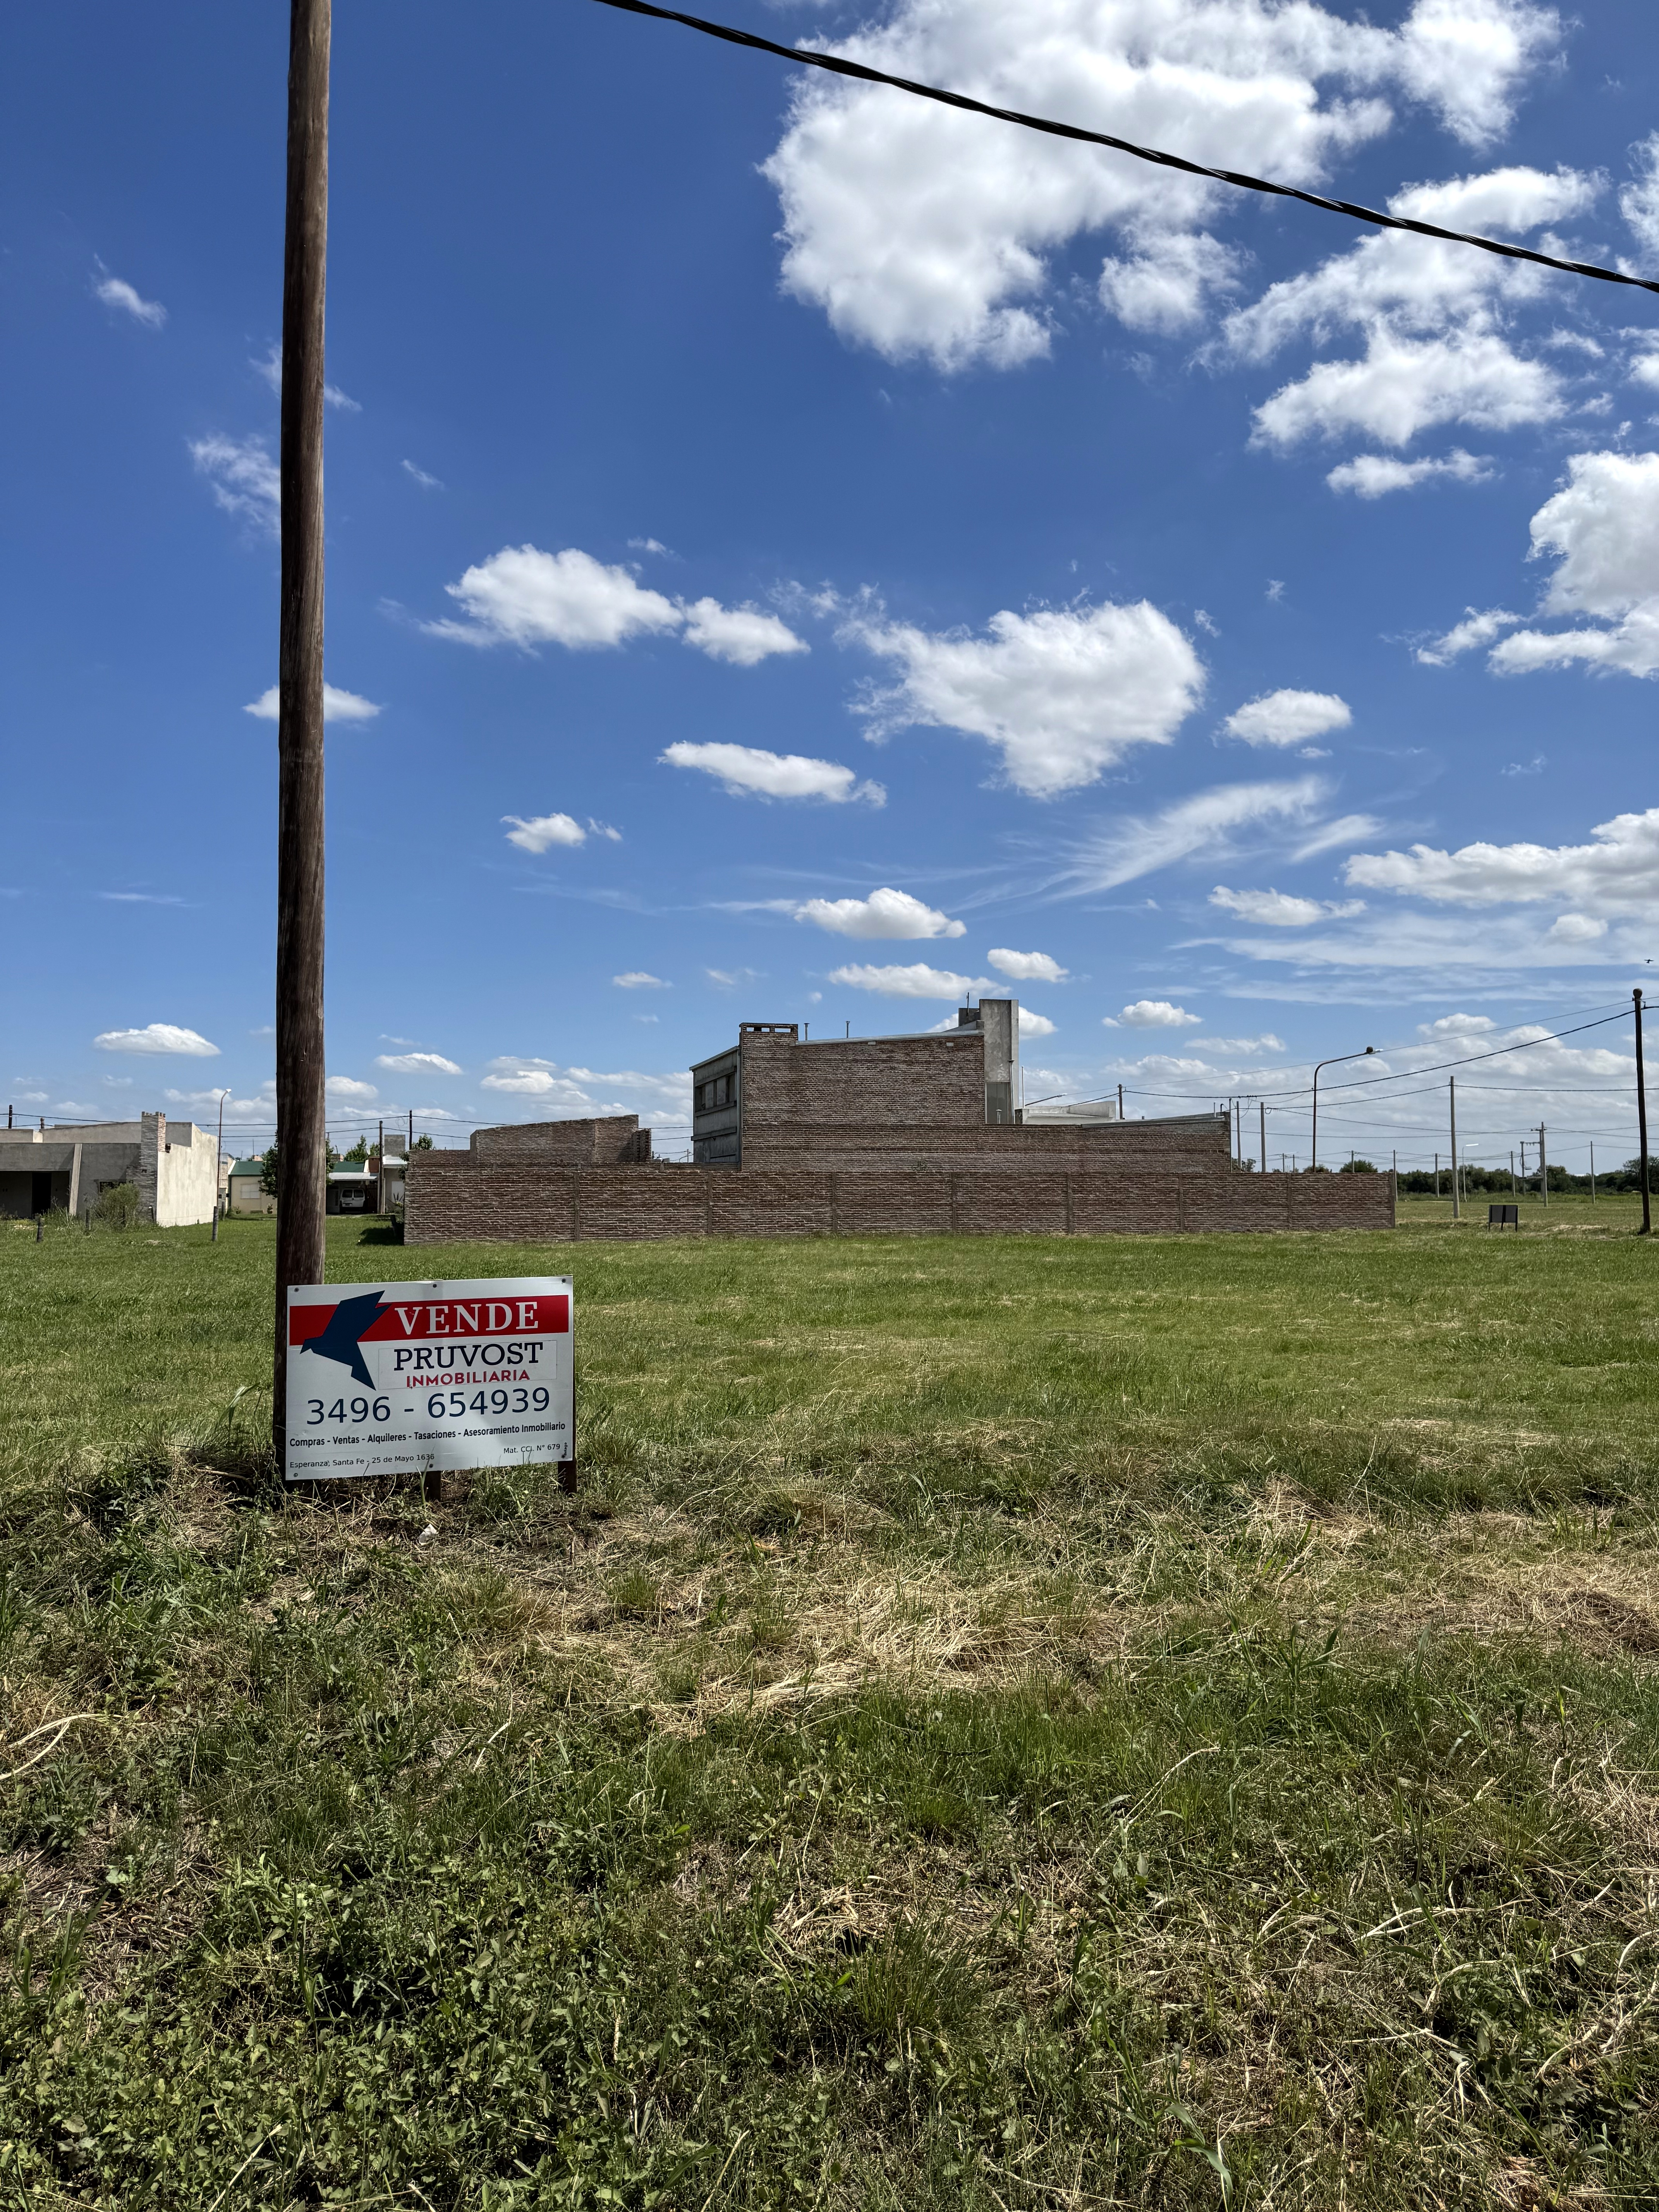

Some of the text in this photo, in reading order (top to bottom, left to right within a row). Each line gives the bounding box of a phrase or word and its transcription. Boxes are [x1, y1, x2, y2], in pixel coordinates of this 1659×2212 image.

[394, 1302, 538, 1335] VENDE
[394, 1342, 543, 1371] PRUVOST
[406, 1369, 531, 1388] INMOBILIARIA
[307, 1396, 391, 1425] 3496
[428, 1387, 550, 1419] 654939
[290, 1438, 325, 1448] Compras
[333, 1436, 360, 1444] Ventas
[367, 1433, 407, 1444] Alquileres
[414, 1430, 456, 1440] Tasaciones
[464, 1425, 520, 1437] Asesoramiento
[522, 1422, 565, 1432] Inmobiliario
[290, 1460, 330, 1468] Esperanza,
